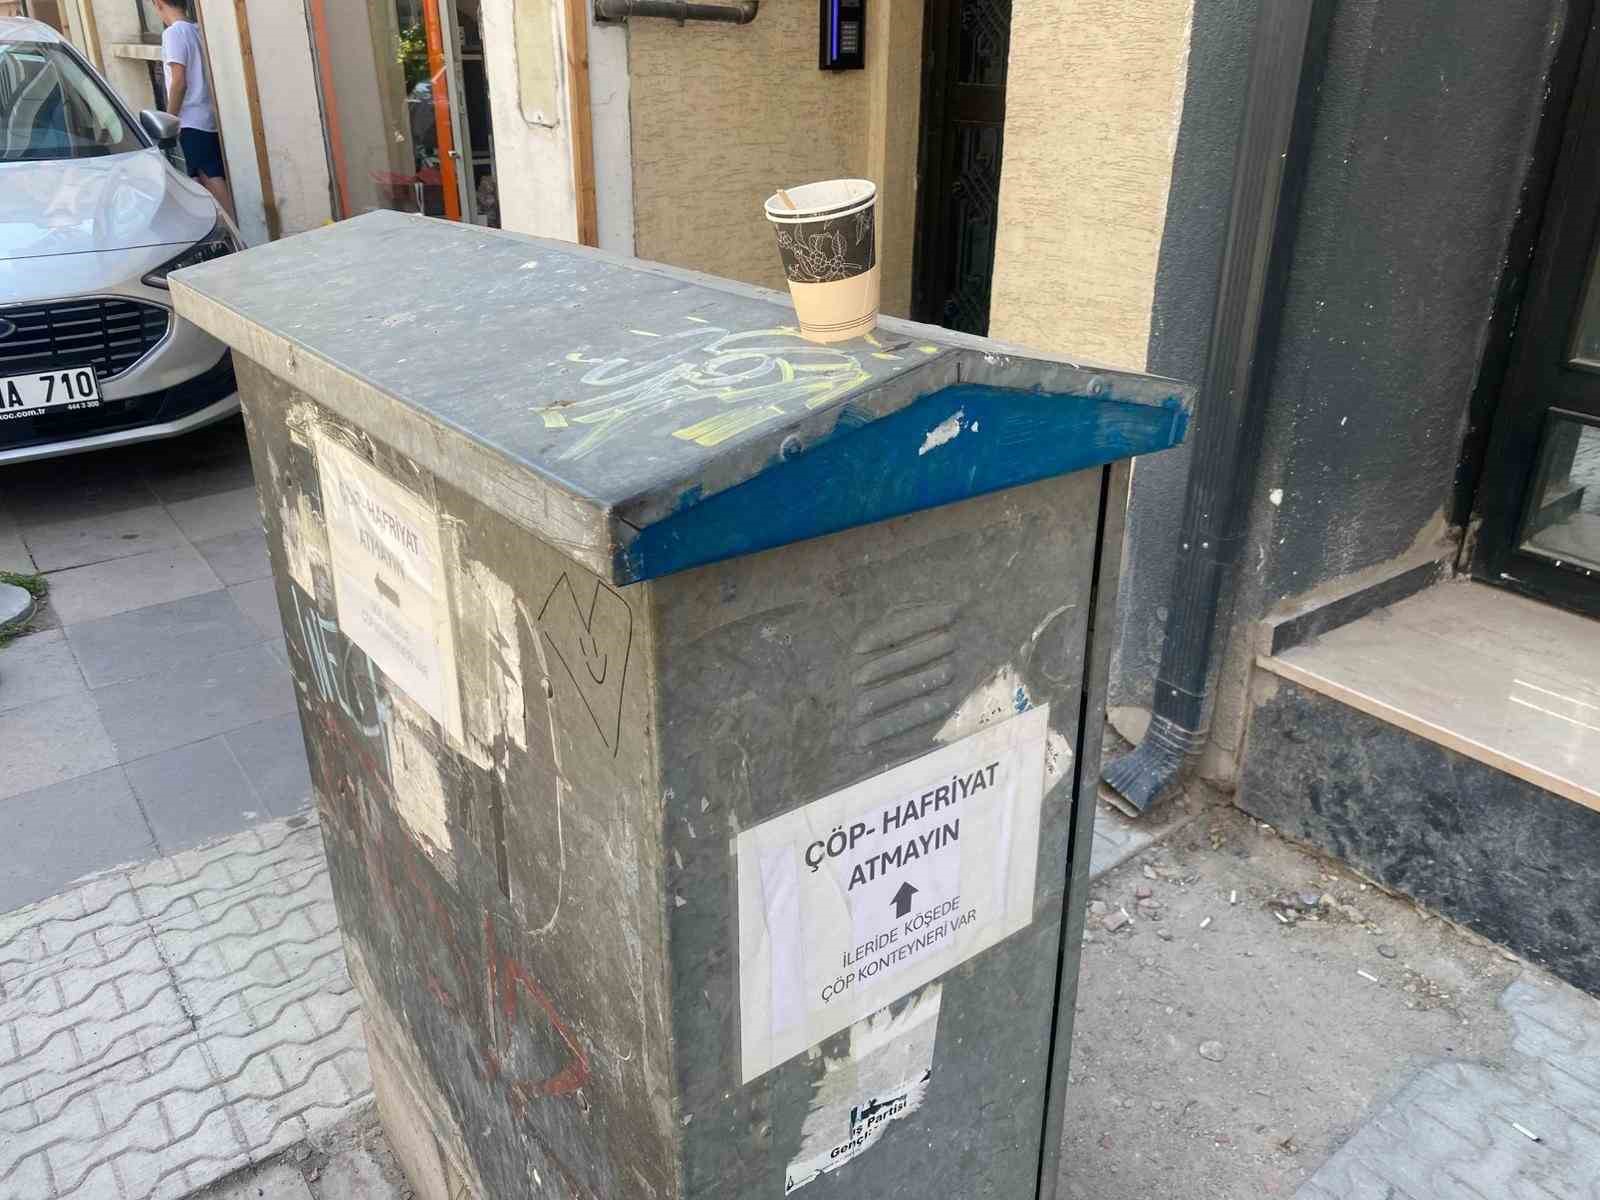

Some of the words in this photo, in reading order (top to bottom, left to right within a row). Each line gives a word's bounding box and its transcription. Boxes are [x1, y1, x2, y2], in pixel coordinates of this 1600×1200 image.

[39, 371, 94, 403] 710
[805, 822, 876, 873] ÇÖP-
[882, 762, 999, 834] HAFRİYAT
[848, 819, 960, 891] ATMAYIN
[821, 973, 856, 1004] ÇÖP
[858, 922, 948, 982] KONTEYNERİ
[950, 909, 977, 932] VAR
[842, 927, 899, 968] İLERİDE
[904, 895, 961, 936] KÖŞEDE
[867, 1100, 908, 1127] Partisi
